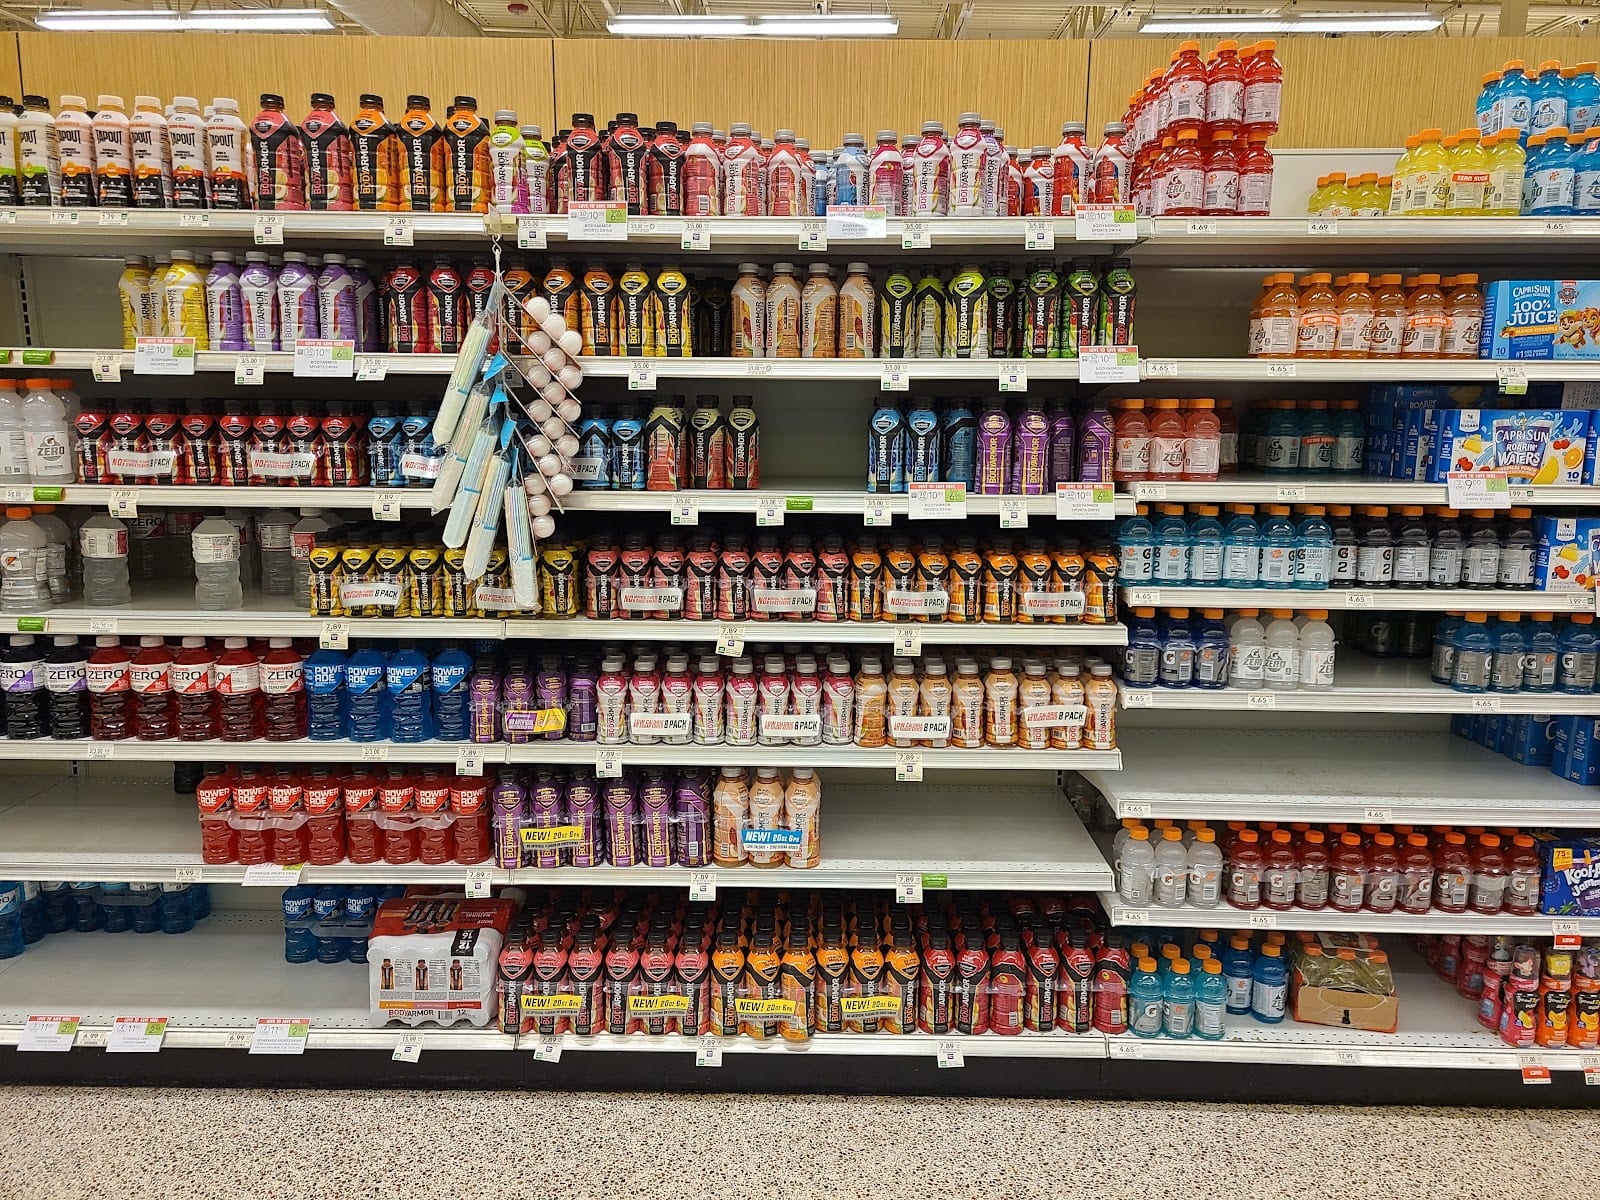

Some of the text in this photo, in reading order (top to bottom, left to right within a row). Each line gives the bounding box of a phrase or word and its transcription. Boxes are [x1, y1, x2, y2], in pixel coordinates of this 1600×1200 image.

[95, 129, 122, 145] TAPOUT
[170, 131, 195, 147] TAPOUT
[209, 133, 234, 149] TAPOUT
[261, 141, 272, 195] BODYARMOR
[310, 140, 321, 195] BODYARMOR
[359, 137, 371, 195] BODYARMOR
[413, 138, 424, 196] BODYARMOR
[457, 139, 467, 196] BODYARMOR
[627, 152, 637, 203] BODYARMOR
[668, 161, 679, 209] BODYARMOR
[960, 154, 969, 203] BODYARMOR
[1513, 300, 1551, 312] 100%
[257, 291, 265, 339] BODYARMOR
[399, 294, 410, 341] BODYARMOR
[599, 295, 608, 343] BODYARMOR
[629, 296, 638, 344] BODYARMOR
[667, 296, 677, 344] BODYARMOR
[959, 298, 969, 346] BODYARMOR
[1117, 295, 1128, 345] BODYARMOR
[1506, 310, 1557, 326] JUICE
[894, 300, 902, 347] BODYARMOR
[38, 447, 65, 456] ZERO
[696, 432, 704, 477] BODYARMOR
[737, 432, 746, 477] BODYARMOR
[879, 435, 887, 481] BODYARMOR
[1498, 452, 1540, 466] WATERS
[989, 438, 998, 484] BODYARMOR
[1029, 438, 1039, 484] BODYARMOR
[1143, 562, 1150, 573] 2
[1338, 562, 1348, 573] 2
[1382, 564, 1391, 574] 2
[380, 589, 398, 598] PACK
[929, 598, 945, 607] PACK
[1065, 599, 1082, 608] PACK
[49, 668, 85, 679] ZERO
[88, 670, 124, 679] ZERO
[268, 669, 301, 679] ZERO
[348, 667, 382, 676] POWER
[387, 667, 417, 676] POWER
[433, 667, 464, 675] POWER
[669, 720, 687, 729] PACK
[1064, 712, 1084, 721] PACK
[799, 721, 818, 730] PACK
[929, 722, 948, 732] PACK
[200, 788, 229, 798] POWER
[238, 787, 268, 797] POWER
[272, 787, 302, 796] POWER
[309, 788, 339, 798] POWER
[346, 789, 373, 798] POWER
[385, 788, 412, 798] POWER
[420, 789, 448, 798] POWER
[461, 787, 488, 798] POWER
[506, 813, 514, 858] BODYARMOR
[525, 831, 550, 841] NEW!
[619, 811, 627, 857] BODYARMOR
[745, 831, 771, 842] NEW!
[285, 898, 311, 907] POWER
[508, 980, 516, 1025] BODYARMOR
[508, 981, 517, 1025] BODYARMOR
[524, 998, 550, 1007] NEW!
[632, 998, 657, 1008] NEW!
[727, 981, 735, 1026] BODYARMOR
[738, 1001, 765, 1011] NEW!
[831, 977, 840, 1022] BODYARMOR
[845, 1000, 870, 1010] NEW!
[906, 980, 914, 1024] BODYARMOR
[962, 978, 970, 1024] BODYARMOR
[1044, 978, 1052, 1022] BODYARMOR
[1080, 978, 1089, 1023] BODYARMOR
